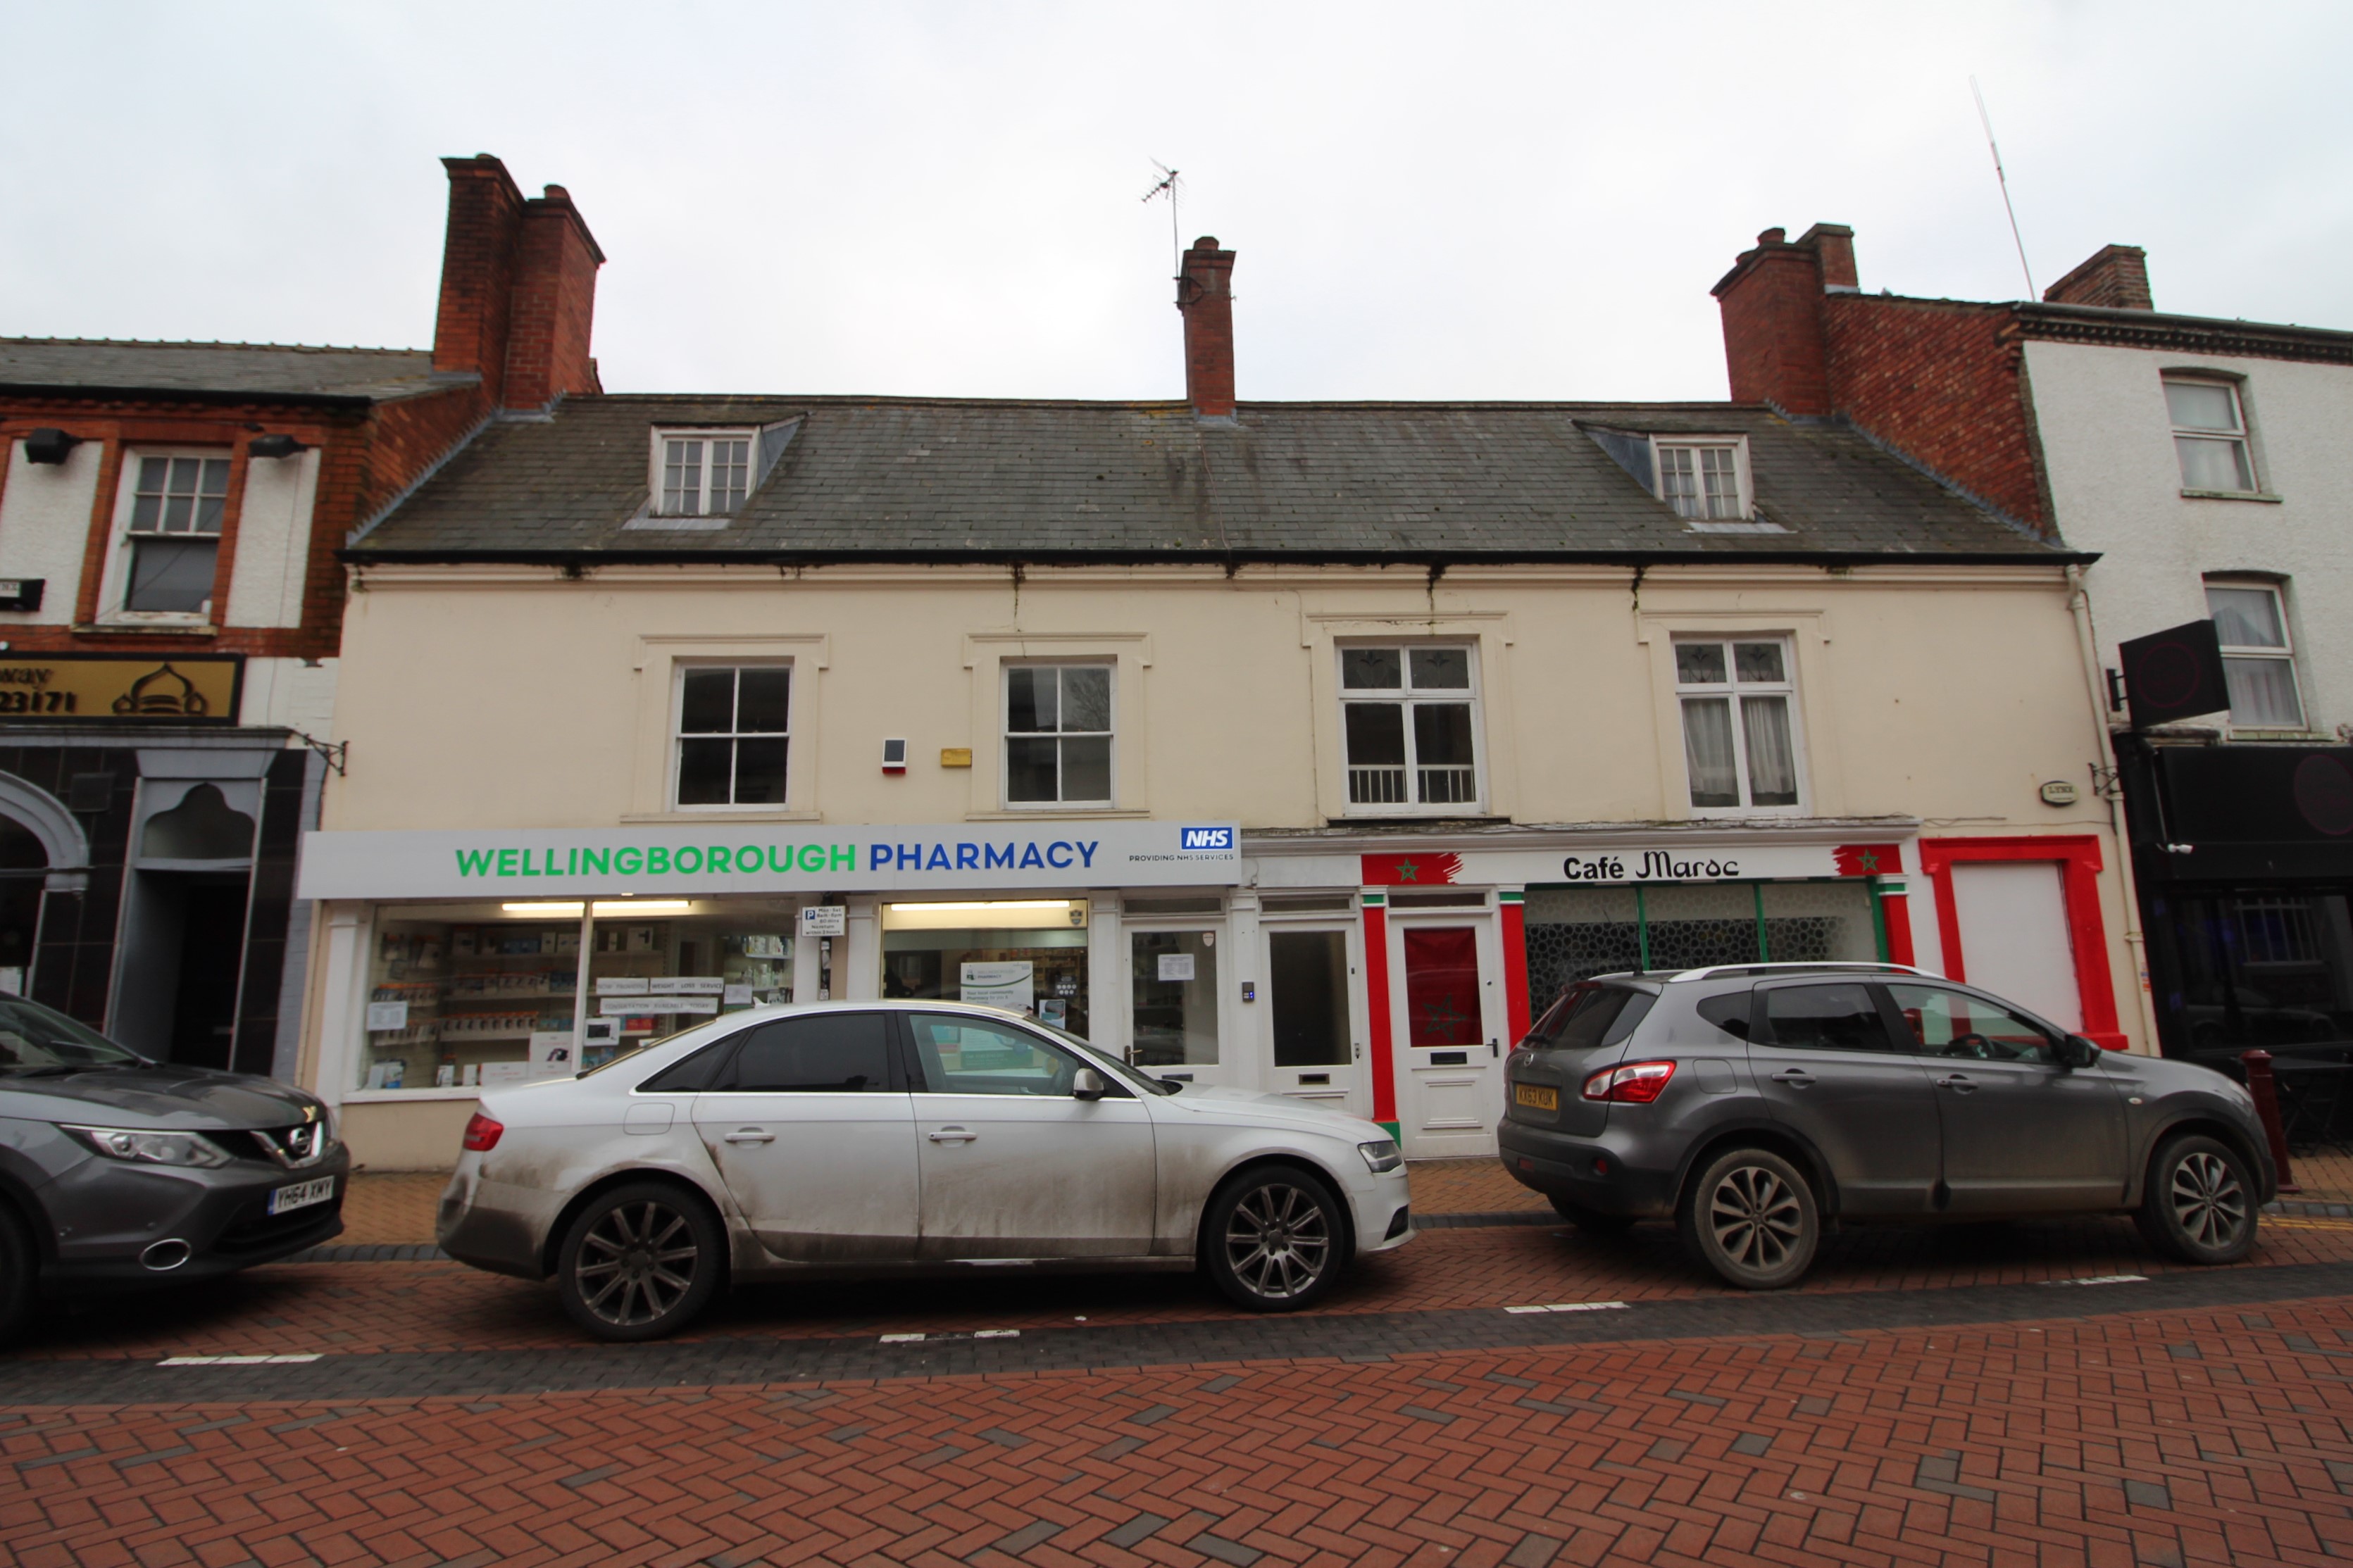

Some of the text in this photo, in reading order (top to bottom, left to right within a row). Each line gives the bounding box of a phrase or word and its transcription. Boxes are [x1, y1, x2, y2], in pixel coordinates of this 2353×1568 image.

[1186, 830, 1228, 847] NHS
[456, 841, 1099, 877] WELLINGBOROUGH PHARMACY
[1564, 851, 1740, 879] Café Maroc
[807, 910, 814, 919] P
